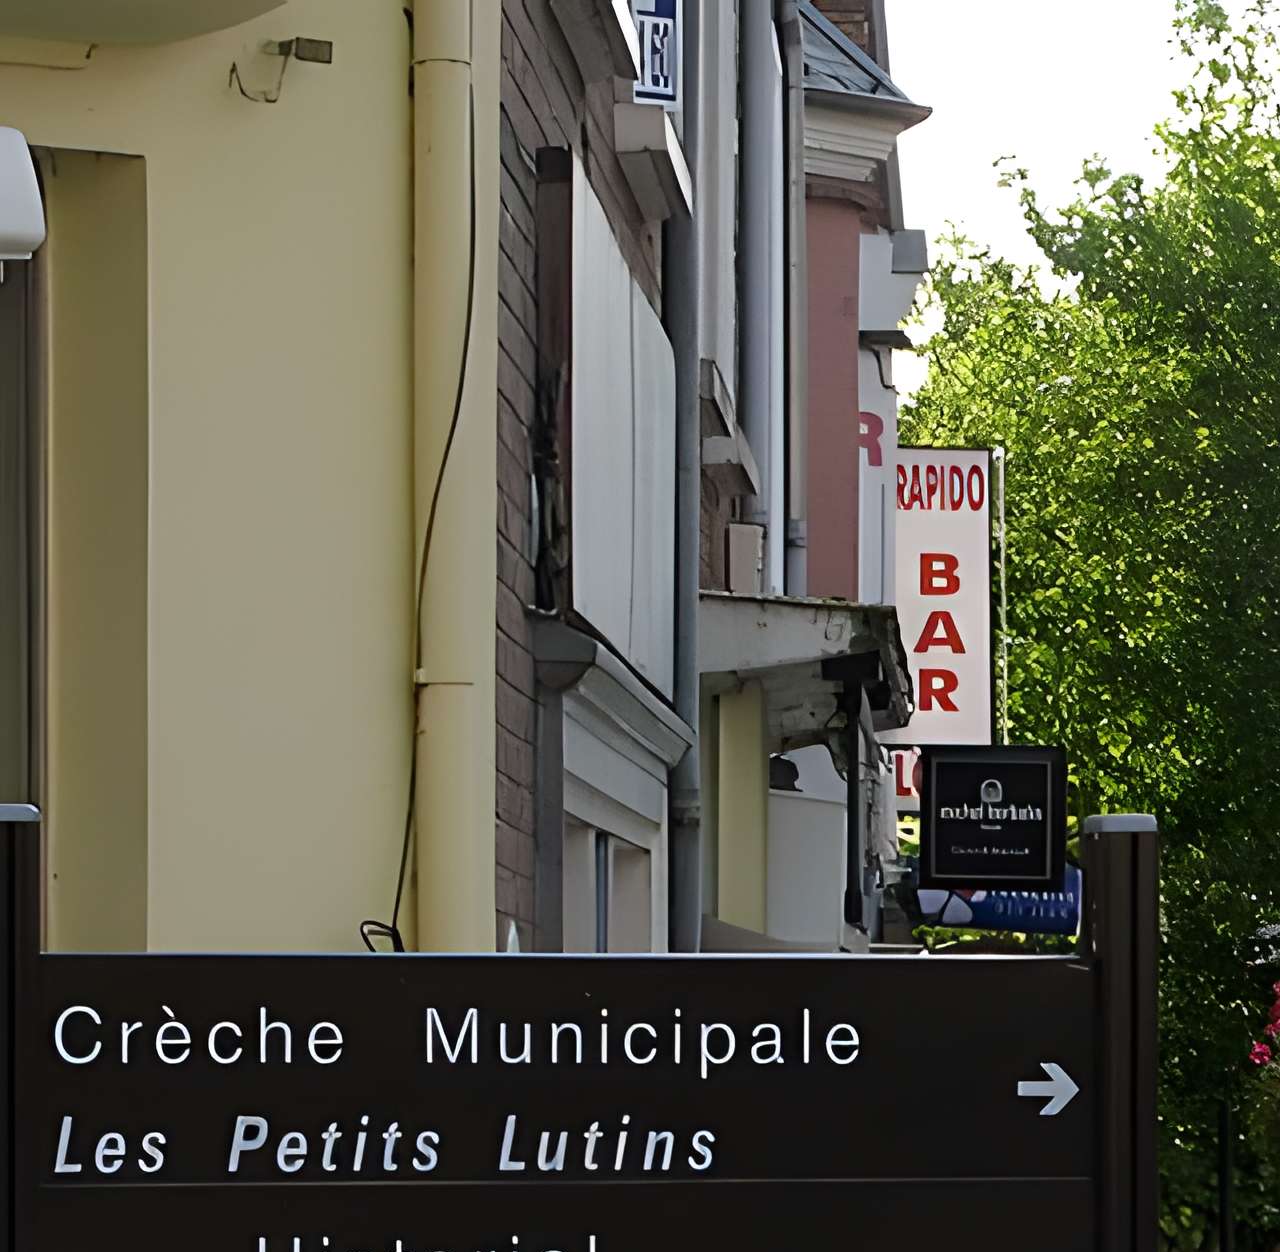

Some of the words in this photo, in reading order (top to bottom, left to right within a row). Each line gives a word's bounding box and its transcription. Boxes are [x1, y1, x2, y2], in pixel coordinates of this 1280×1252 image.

[896, 463, 985, 512] RAPIDO
[912, 552, 967, 713] BAR
[54, 1005, 344, 1065] Crèche
[426, 1007, 860, 1080] Municipale
[54, 1115, 167, 1174] Les
[228, 1115, 440, 1173] Petits
[499, 1114, 716, 1172] Lutins
